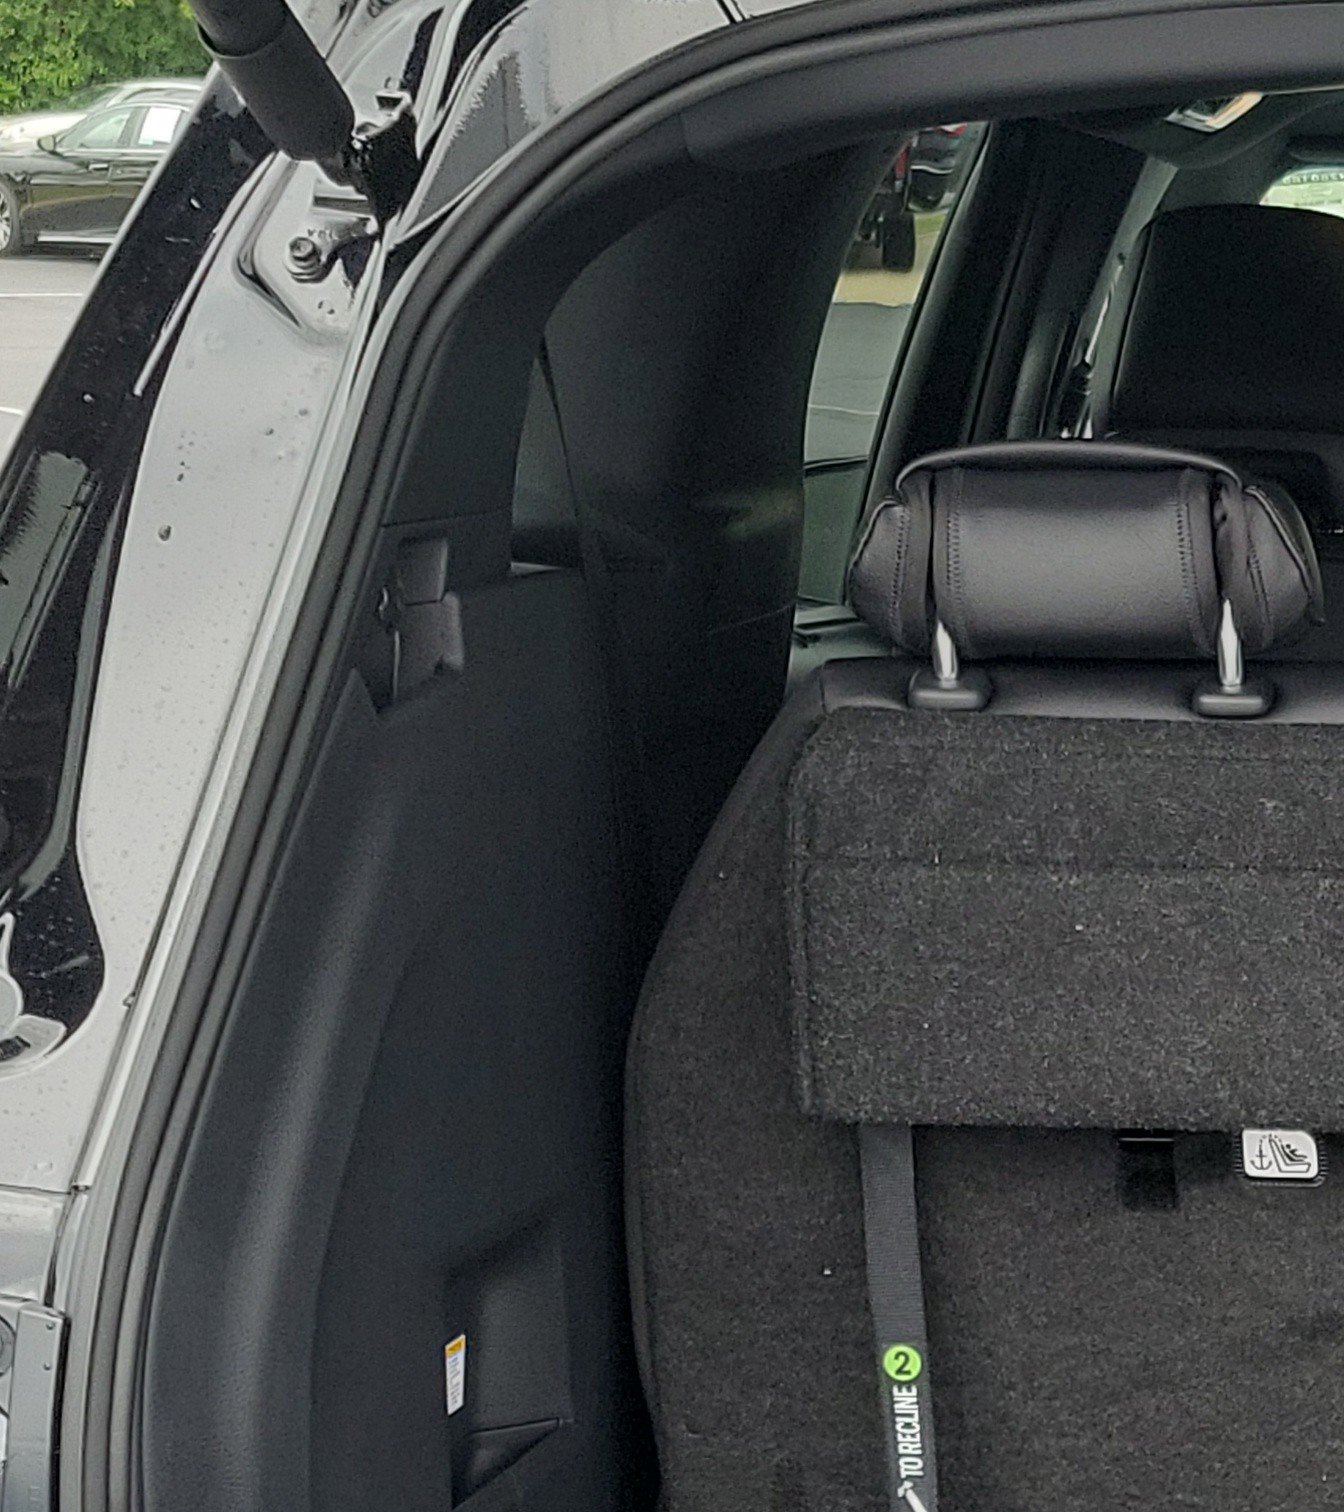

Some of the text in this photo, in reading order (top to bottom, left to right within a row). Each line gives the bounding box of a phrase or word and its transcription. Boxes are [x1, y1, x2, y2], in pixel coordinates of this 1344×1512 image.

[893, 1351, 911, 1376] 2
[893, 1385, 924, 1478] TO RECLINE
